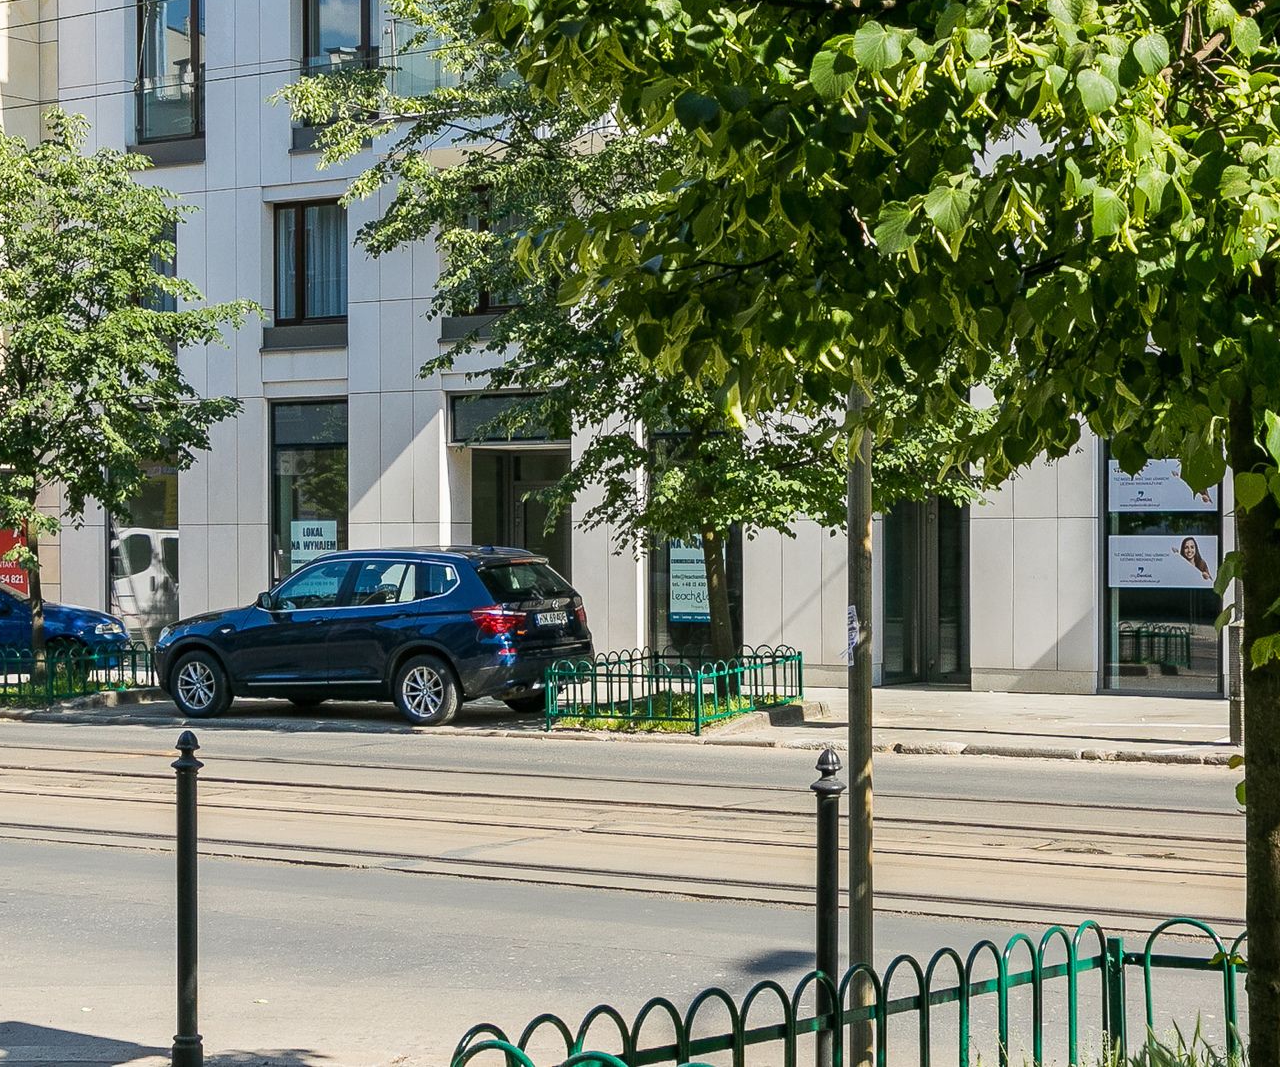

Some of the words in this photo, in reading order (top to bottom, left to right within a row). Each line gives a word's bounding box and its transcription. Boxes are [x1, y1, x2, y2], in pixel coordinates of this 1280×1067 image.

[302, 527, 323, 537] LOKAL
[291, 541, 300, 550] NA
[303, 541, 336, 550] WYNAJEM
[10, 574, 24, 584] 821
